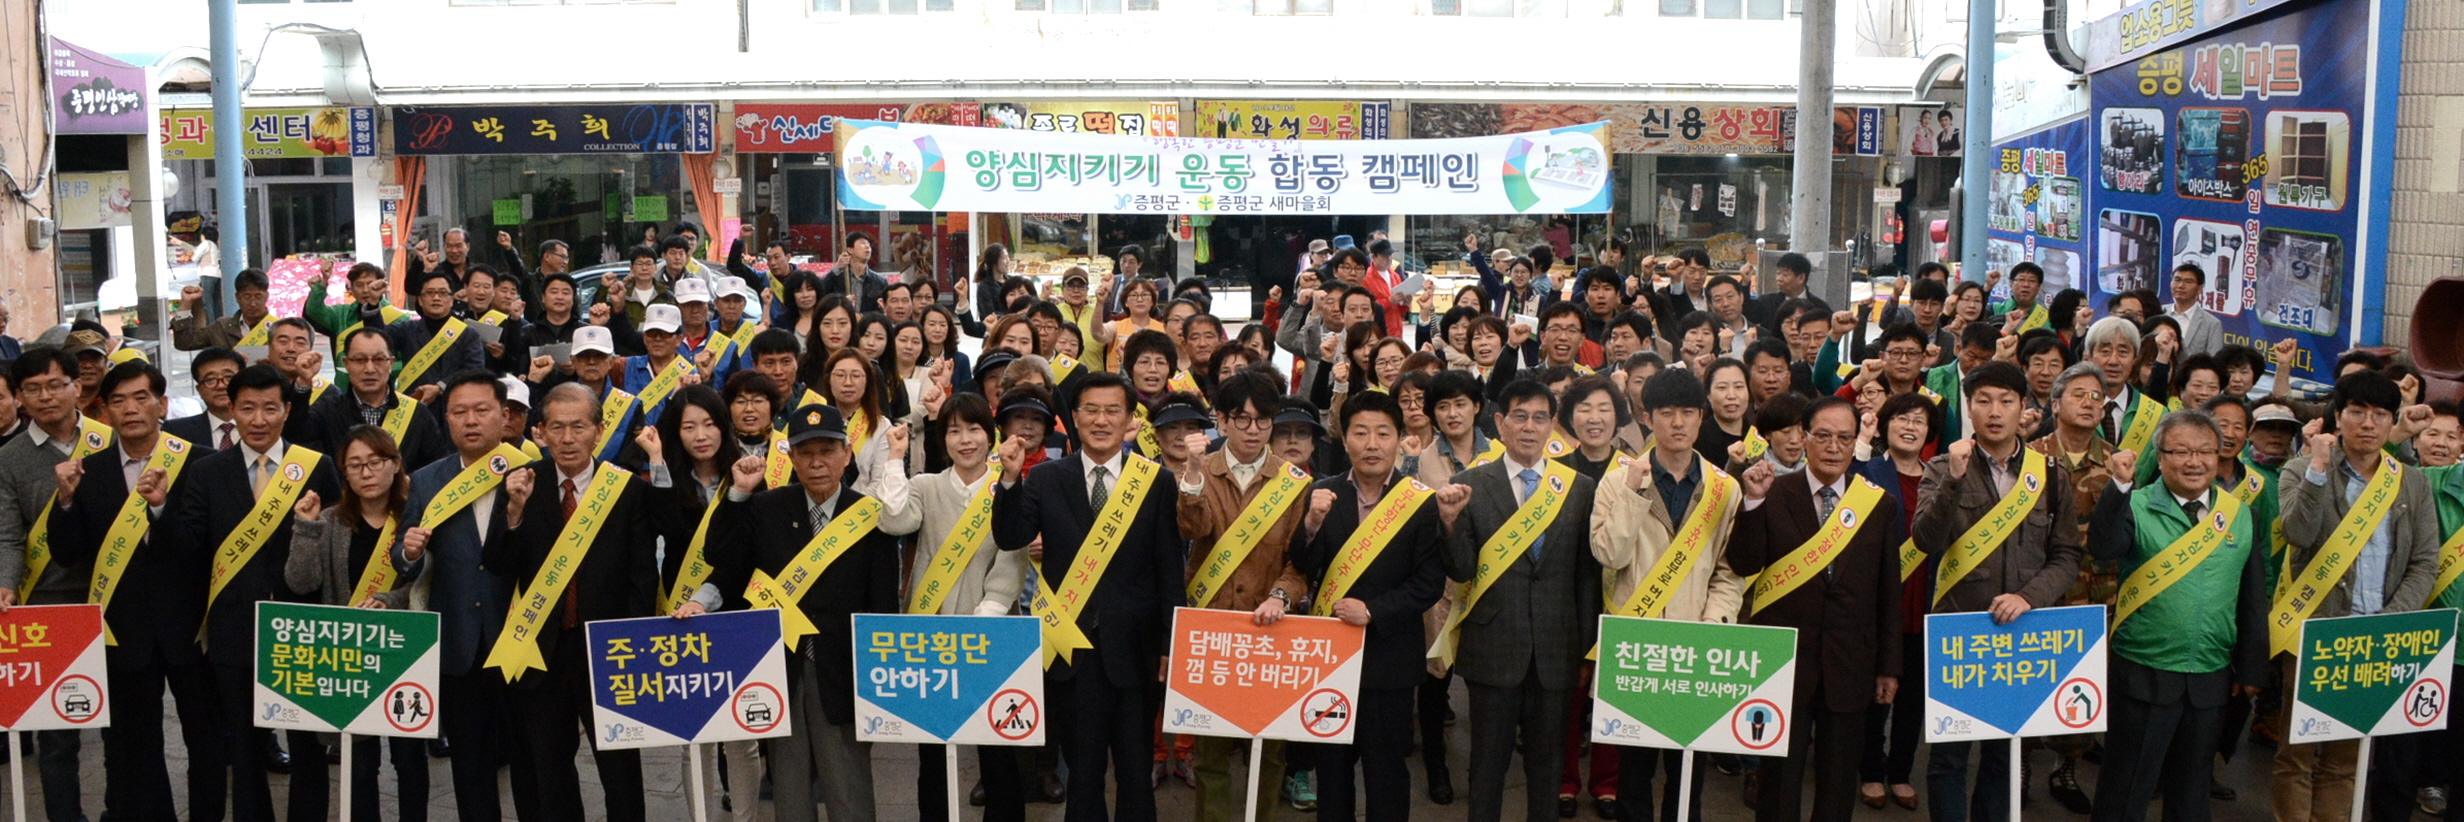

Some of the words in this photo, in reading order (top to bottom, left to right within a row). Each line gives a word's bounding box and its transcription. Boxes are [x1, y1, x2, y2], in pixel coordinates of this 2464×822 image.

[2190, 43, 2301, 99] 세일마트
[249, 114, 313, 143] 센터
[354, 108, 372, 155] 증평청과
[697, 107, 709, 149] 박주희
[1862, 112, 1873, 150] 신용상회
[584, 143, 640, 151] COLLECTION
[2001, 147, 2022, 174] 증평
[2022, 148, 2067, 177] 세일마트
[966, 150, 1158, 190] 양심지키기
[1175, 153, 1251, 190] 운동
[1268, 153, 1345, 190] 합동
[1362, 153, 1475, 190] 캠페인
[2117, 170, 2145, 192] 항아리
[2241, 152, 2270, 184] 365
[1134, 195, 1181, 211] 증평군
[1217, 196, 1264, 211] 증평군
[1269, 196, 1331, 211] 새마을회
[2022, 183, 2040, 207] 365
[2188, 178, 2233, 199] 아이스박스
[2277, 183, 2327, 208] 원목가구
[2244, 219, 2260, 310] 연중무휴
[2278, 303, 2315, 331] 건조대
[1135, 460, 1150, 475] 내
[278, 480, 293, 495] 내
[1120, 477, 1142, 508] 주변
[259, 497, 283, 526] 주변
[568, 471, 620, 548] 양심지키기
[1235, 476, 1296, 546] 양심지키기
[1494, 489, 1557, 560] 양심지키기
[1965, 489, 2031, 557] 양심지키기
[2342, 471, 2395, 547] 양심지키기
[225, 527, 259, 564] 쓰레기
[1093, 508, 1124, 553] 쓰레기
[1802, 524, 1845, 567] 친절한
[106, 537, 126, 568] 운동
[810, 535, 838, 562] 운동
[1208, 550, 1233, 578] 운동
[2145, 526, 2217, 587] 양심지키기
[545, 555, 568, 587] 운동
[1074, 555, 1098, 586] 내가
[1656, 550, 1689, 588] 함부로
[1772, 563, 1802, 587] 인사
[2315, 551, 2341, 582] 운동
[918, 580, 940, 610] 운동
[2277, 583, 2317, 629] 캠페인
[271, 617, 406, 649] 양심지키기는
[513, 592, 547, 642] 캠페인
[270, 643, 381, 674] 문화시민의
[869, 631, 991, 665] 무단횡단
[1188, 630, 1282, 661] 담배꽁초,
[1288, 637, 1338, 665] 휴지,
[1614, 641, 1698, 674] 친절한
[1706, 647, 1762, 679] 인사
[1941, 635, 1964, 660] 내
[1968, 633, 2013, 660] 주변
[2018, 628, 2084, 655] 쓰레기
[271, 670, 371, 699] 기본입니다
[608, 670, 734, 706] 질서지키기
[869, 667, 959, 700] 안하기
[1185, 658, 1205, 685] 껌
[1210, 659, 1231, 687] 등
[1235, 661, 1257, 687] 안
[1260, 664, 1321, 690] 버리기
[1615, 675, 1659, 694] 반갑게
[1662, 678, 1691, 695] 서로
[1695, 680, 1753, 700] 인사하기
[1942, 662, 1987, 690] 내가
[1991, 658, 2057, 687] 치우기
[2310, 664, 2349, 693] 우선
[2353, 660, 2421, 689] 배려하기
